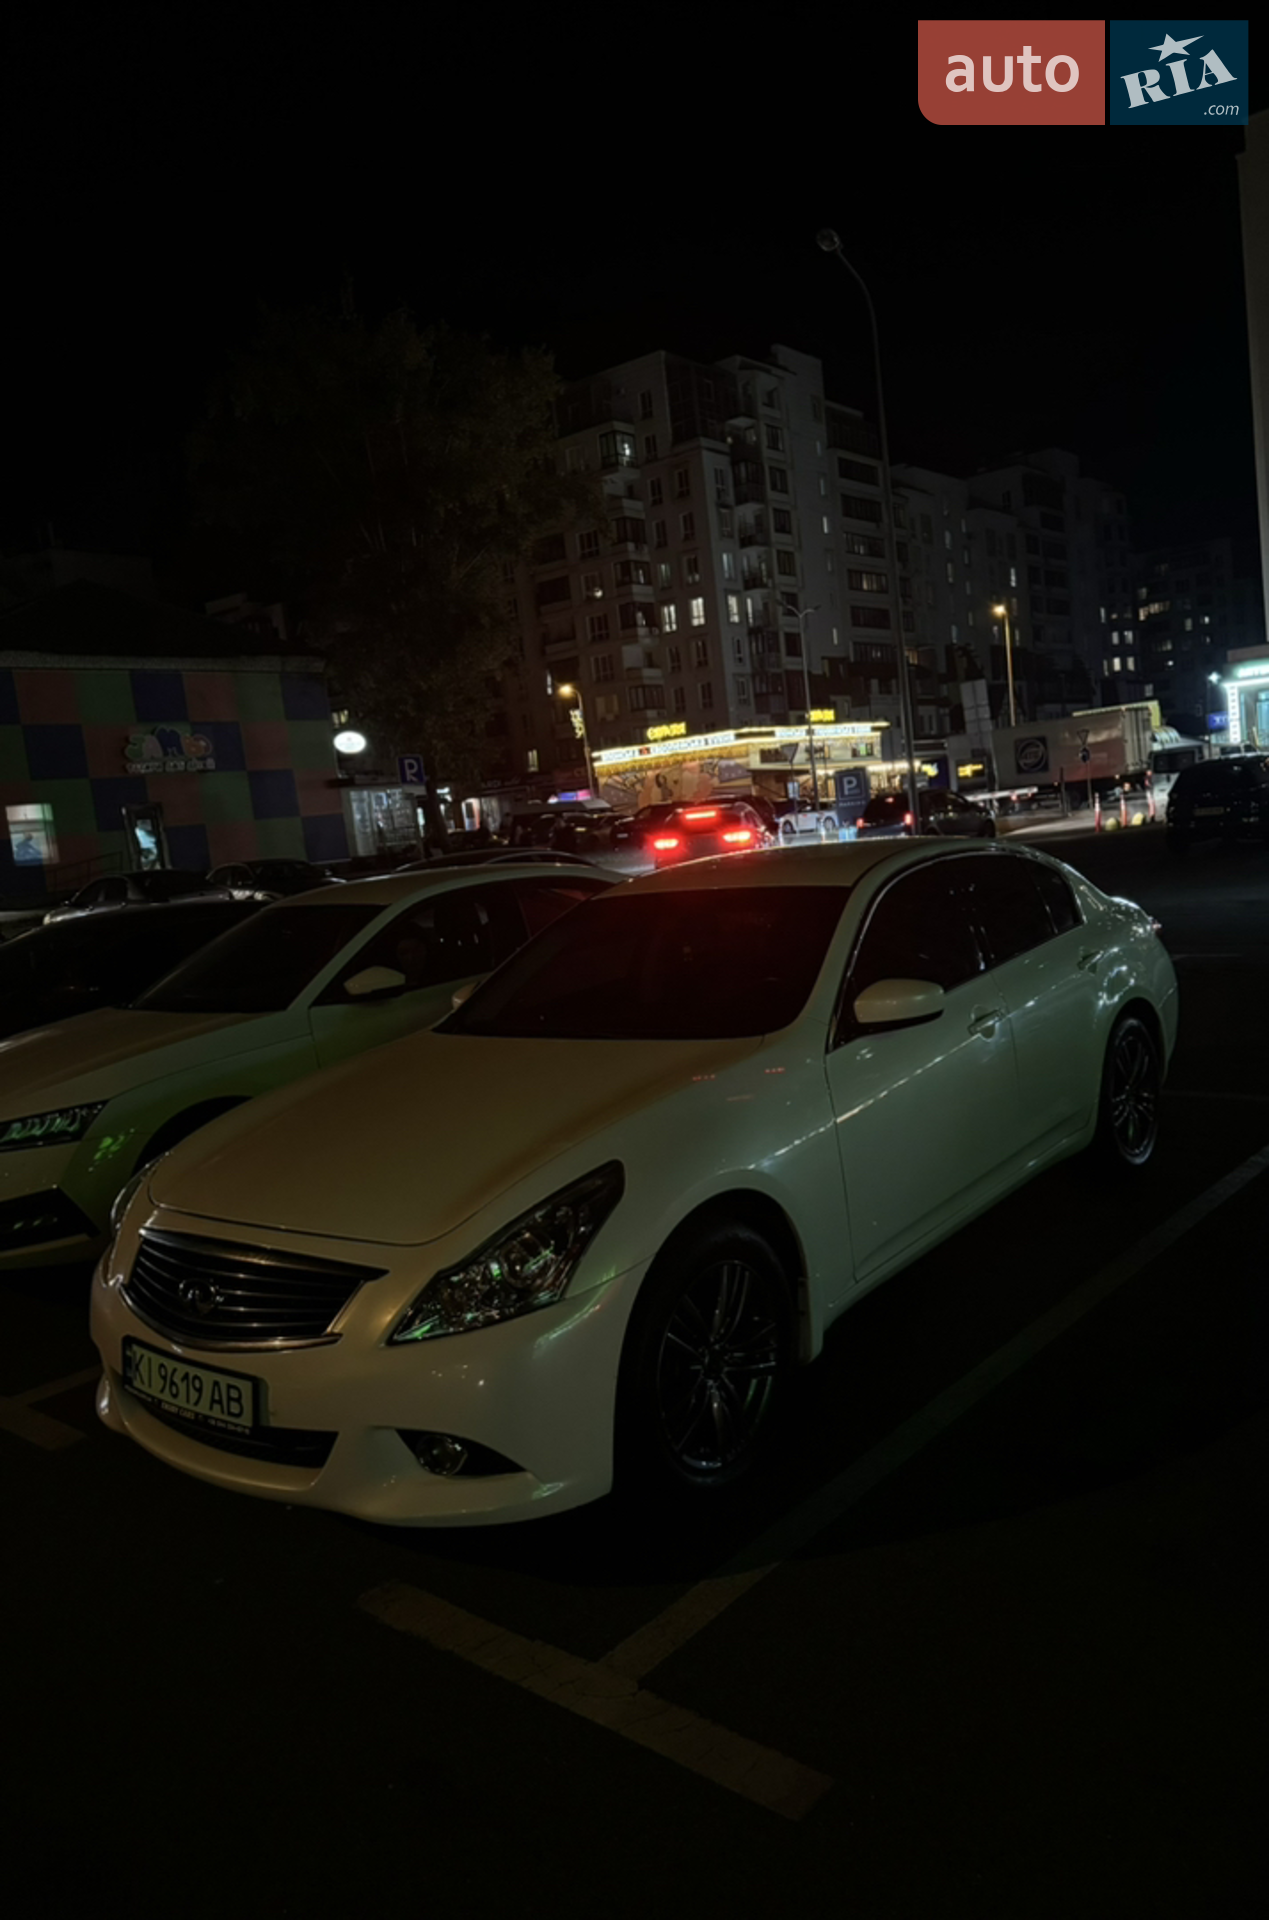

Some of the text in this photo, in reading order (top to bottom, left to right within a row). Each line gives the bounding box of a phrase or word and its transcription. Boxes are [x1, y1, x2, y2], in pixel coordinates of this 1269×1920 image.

[842, 776, 858, 796] P
[158, 1362, 203, 1407] 9619
[209, 1380, 244, 1417] AB
